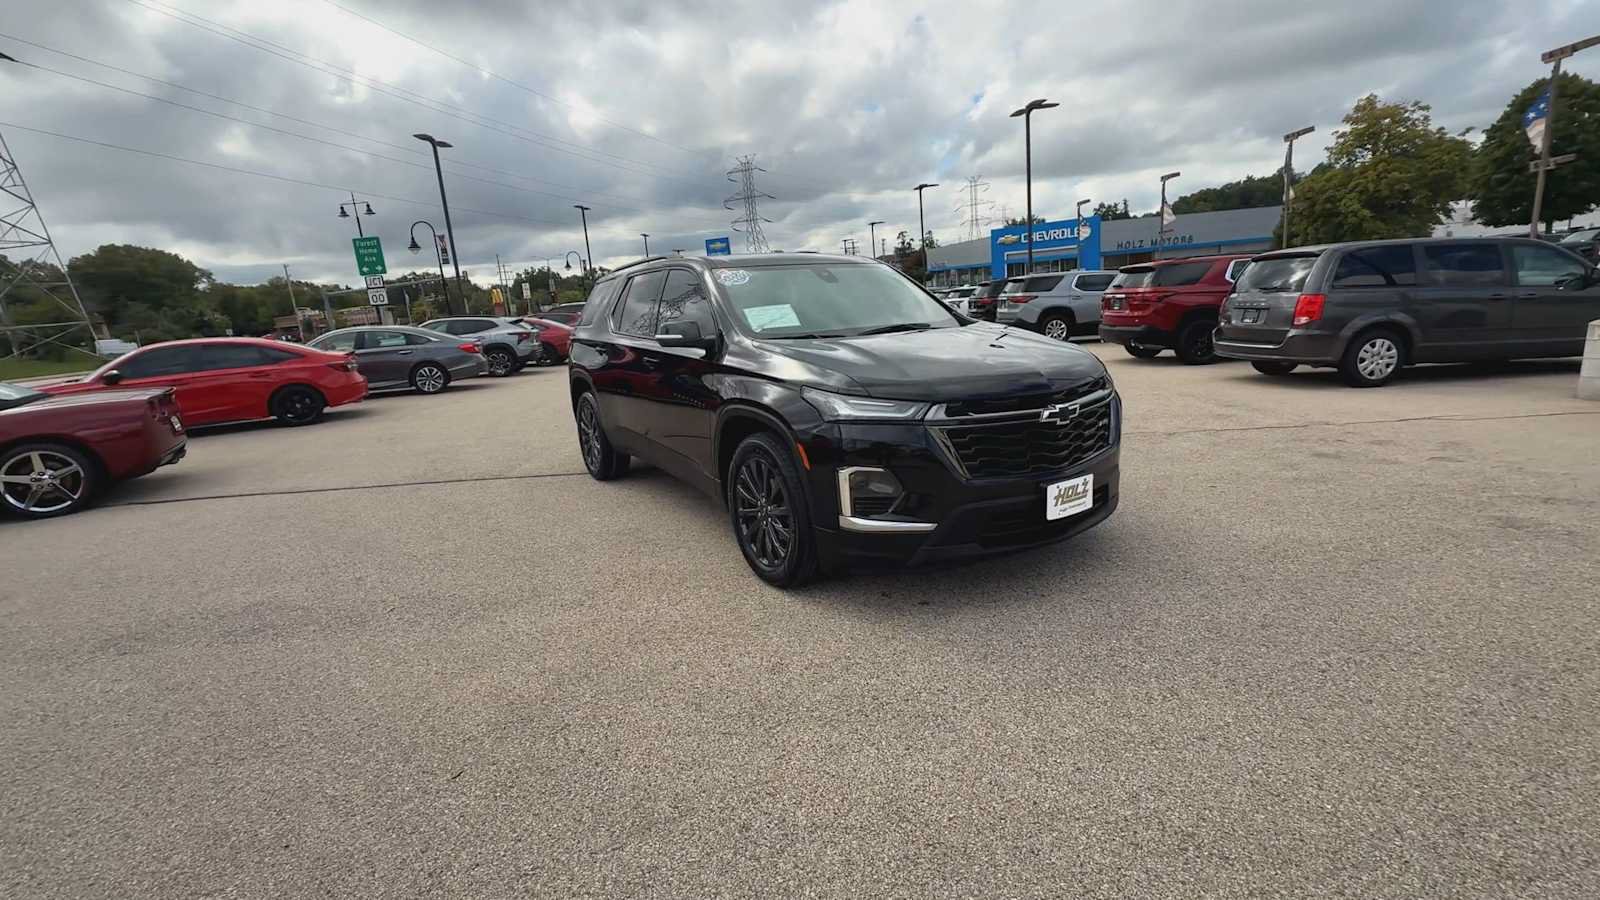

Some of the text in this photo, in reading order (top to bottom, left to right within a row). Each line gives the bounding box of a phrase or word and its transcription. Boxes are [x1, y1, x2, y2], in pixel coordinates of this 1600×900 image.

[1021, 227, 1080, 243] CHEVROLE
[1116, 239, 1144, 249] HOLZ
[368, 278, 382, 286] JCT
[1054, 478, 1088, 507] HOLZ
